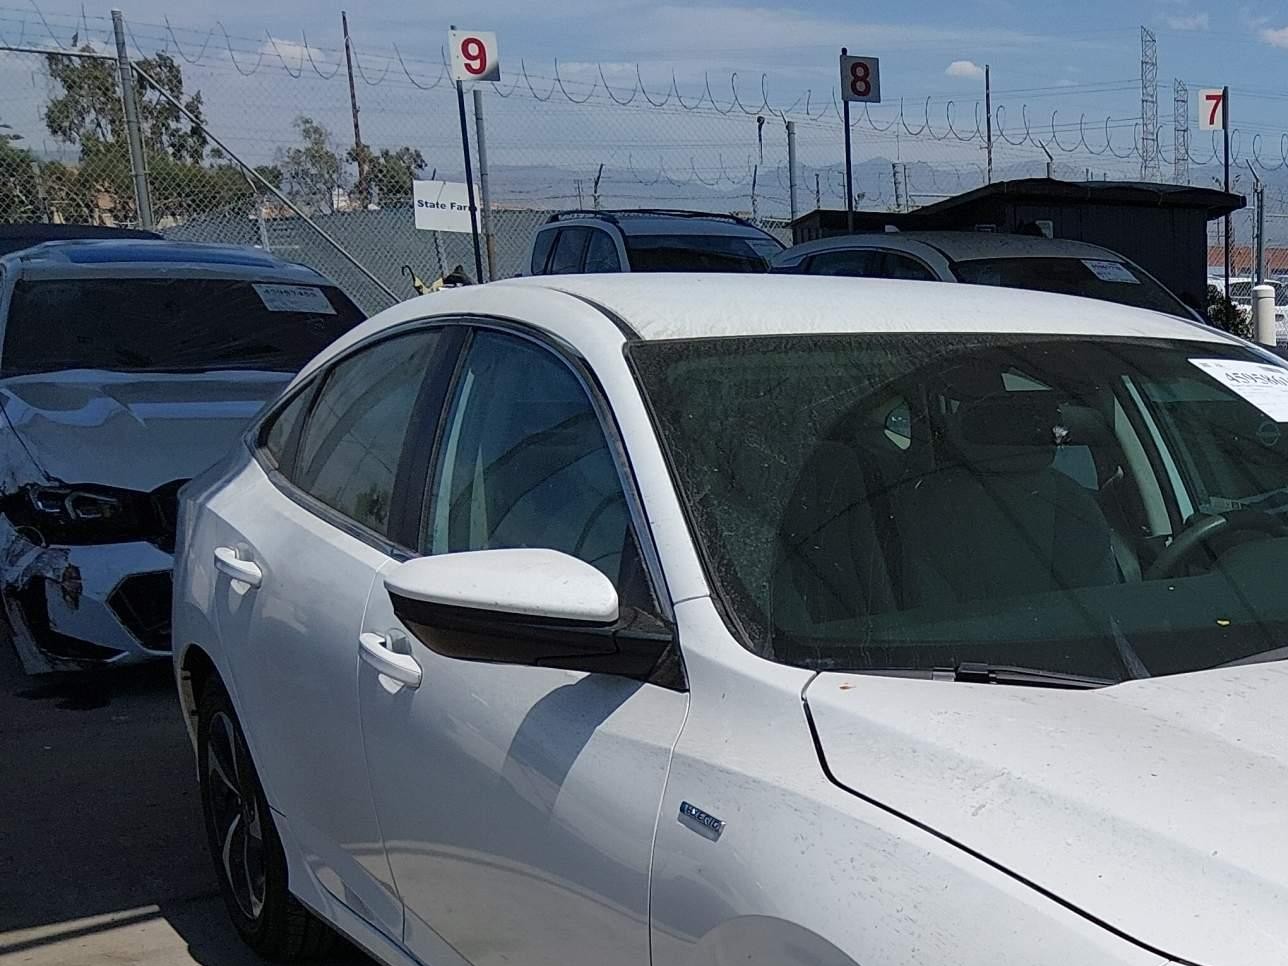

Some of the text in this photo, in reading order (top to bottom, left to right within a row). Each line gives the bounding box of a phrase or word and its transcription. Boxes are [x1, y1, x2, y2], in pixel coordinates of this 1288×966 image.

[461, 37, 487, 75] 9
[850, 62, 871, 97] 8
[1205, 94, 1222, 126] 7
[417, 199, 446, 210] State
